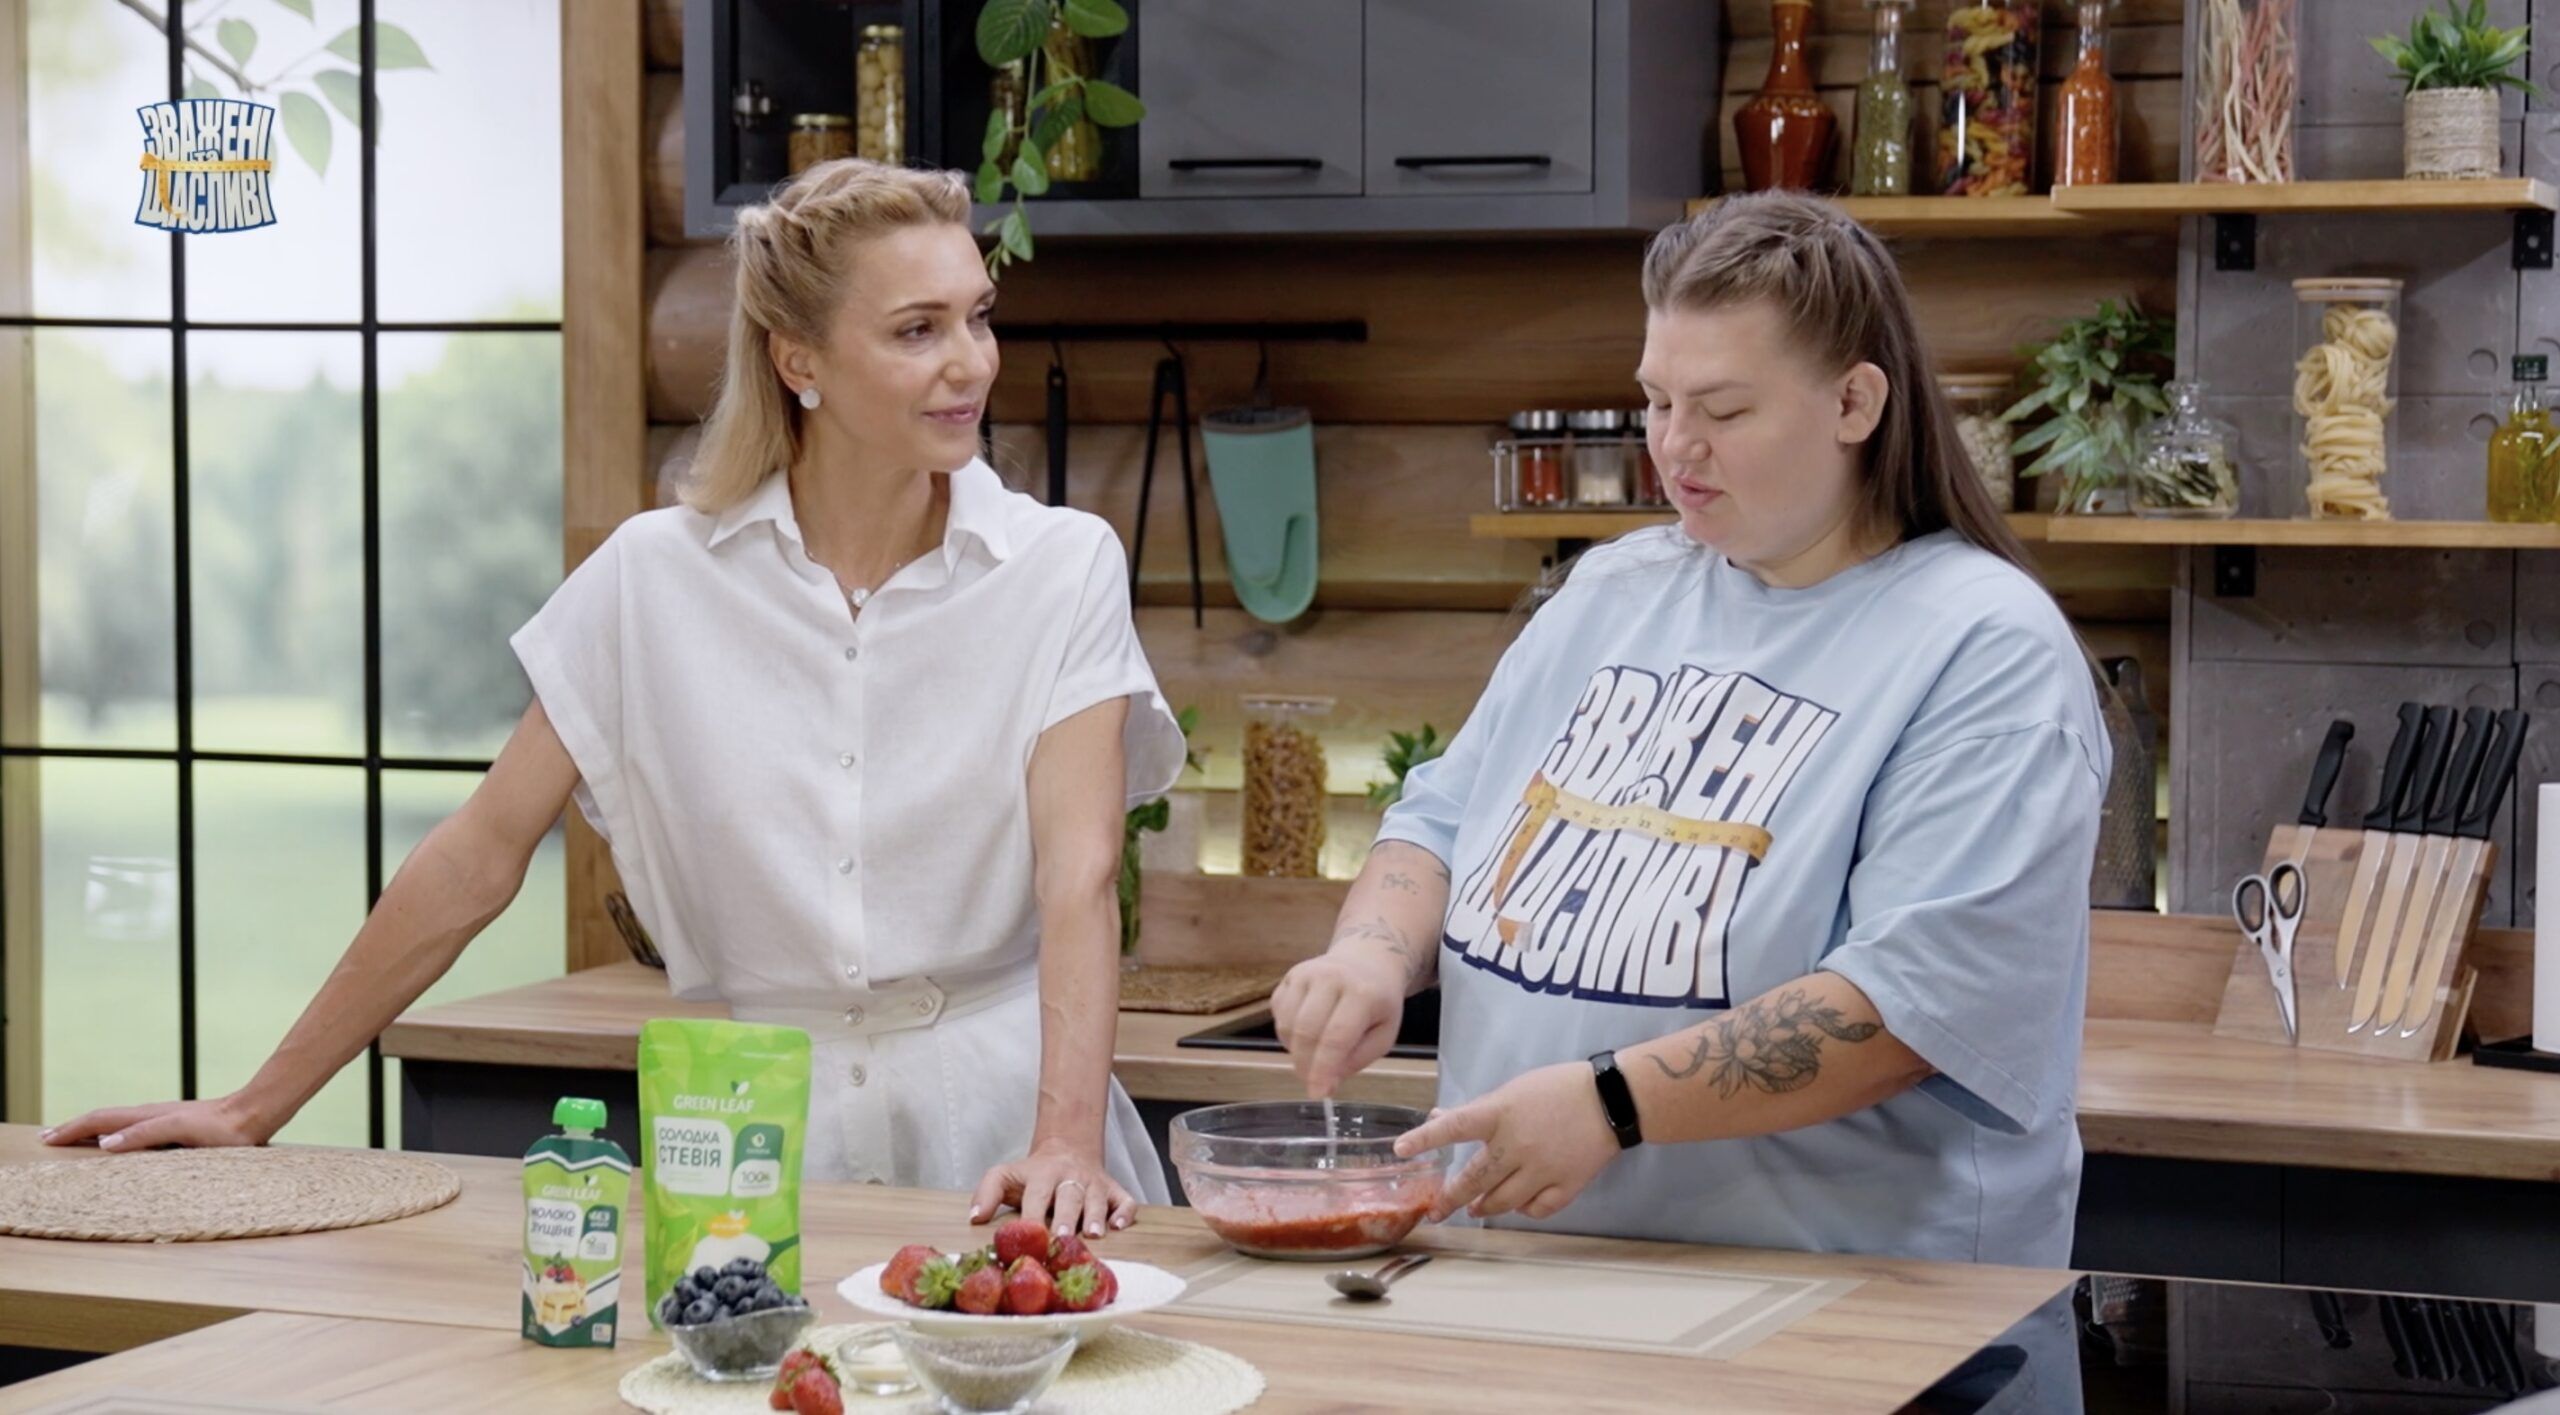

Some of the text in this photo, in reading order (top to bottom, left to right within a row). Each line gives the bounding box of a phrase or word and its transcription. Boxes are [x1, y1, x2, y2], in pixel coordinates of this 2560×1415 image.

[1534, 664, 1842, 832] ЗВАЖЕНІ
[1443, 802, 1752, 1009] ЩАСЛИВІ
[673, 1094, 755, 1114] GREEN LEAF
[659, 1126, 720, 1145] СОЛОДКА
[659, 1145, 722, 1168] СТЕВІЯ
